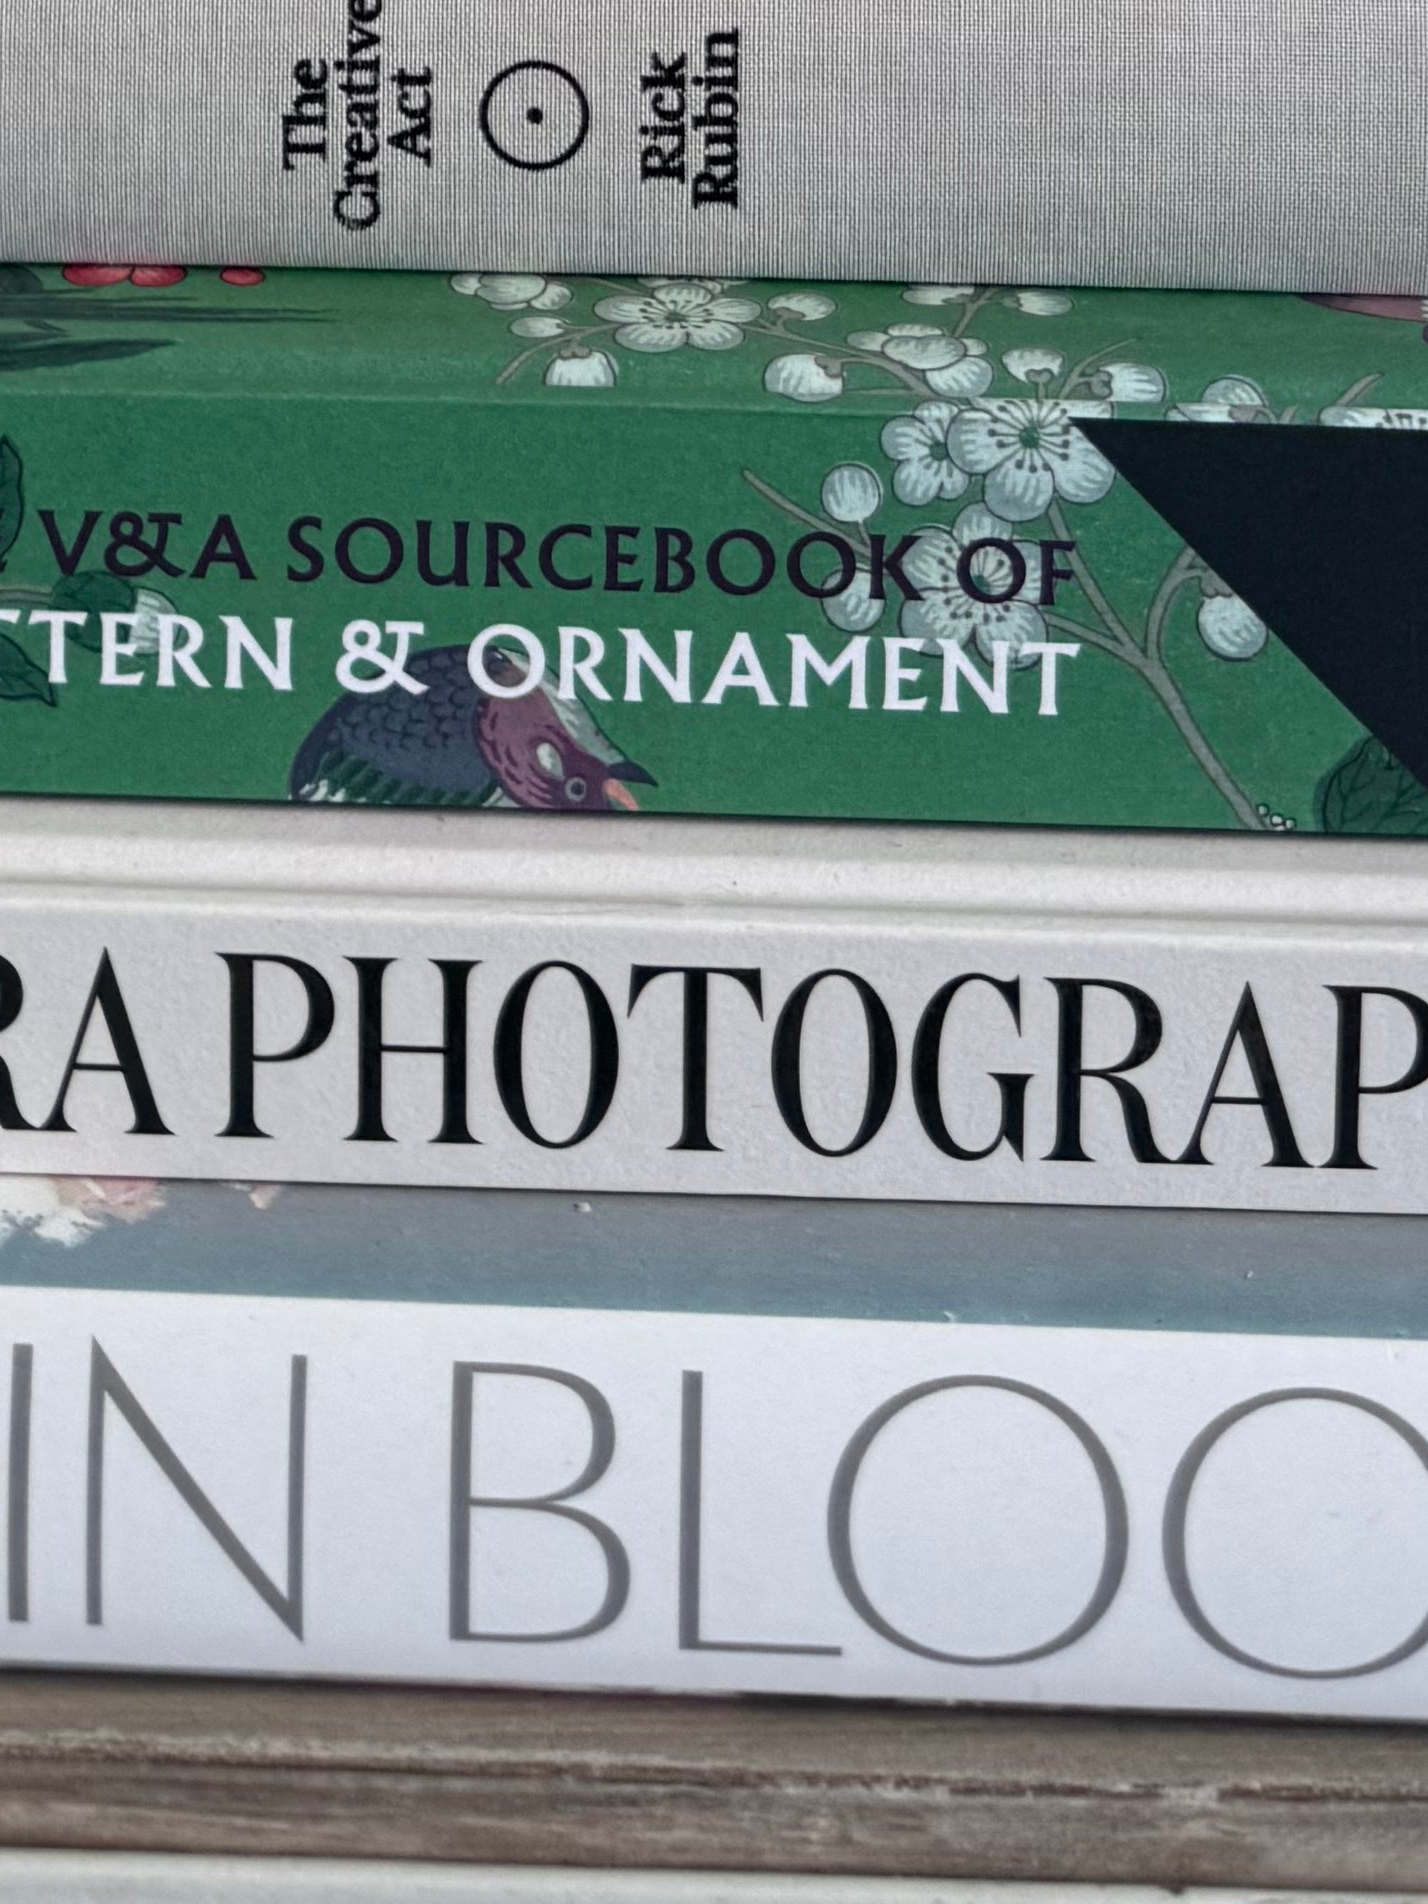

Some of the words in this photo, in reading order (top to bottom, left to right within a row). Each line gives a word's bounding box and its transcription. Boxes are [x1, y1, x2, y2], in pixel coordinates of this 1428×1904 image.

[281, 57, 328, 171] The
[387, 65, 434, 168] Act
[638, 51, 688, 185] Rick
[691, 27, 741, 210] Rubin
[37, 508, 258, 582] V&A
[286, 514, 928, 602] SOURCEBOOK
[955, 536, 1077, 607] OF
[334, 618, 429, 697] &
[467, 623, 1082, 717] ORNAMENT
[2, 1332, 309, 1645] IN
